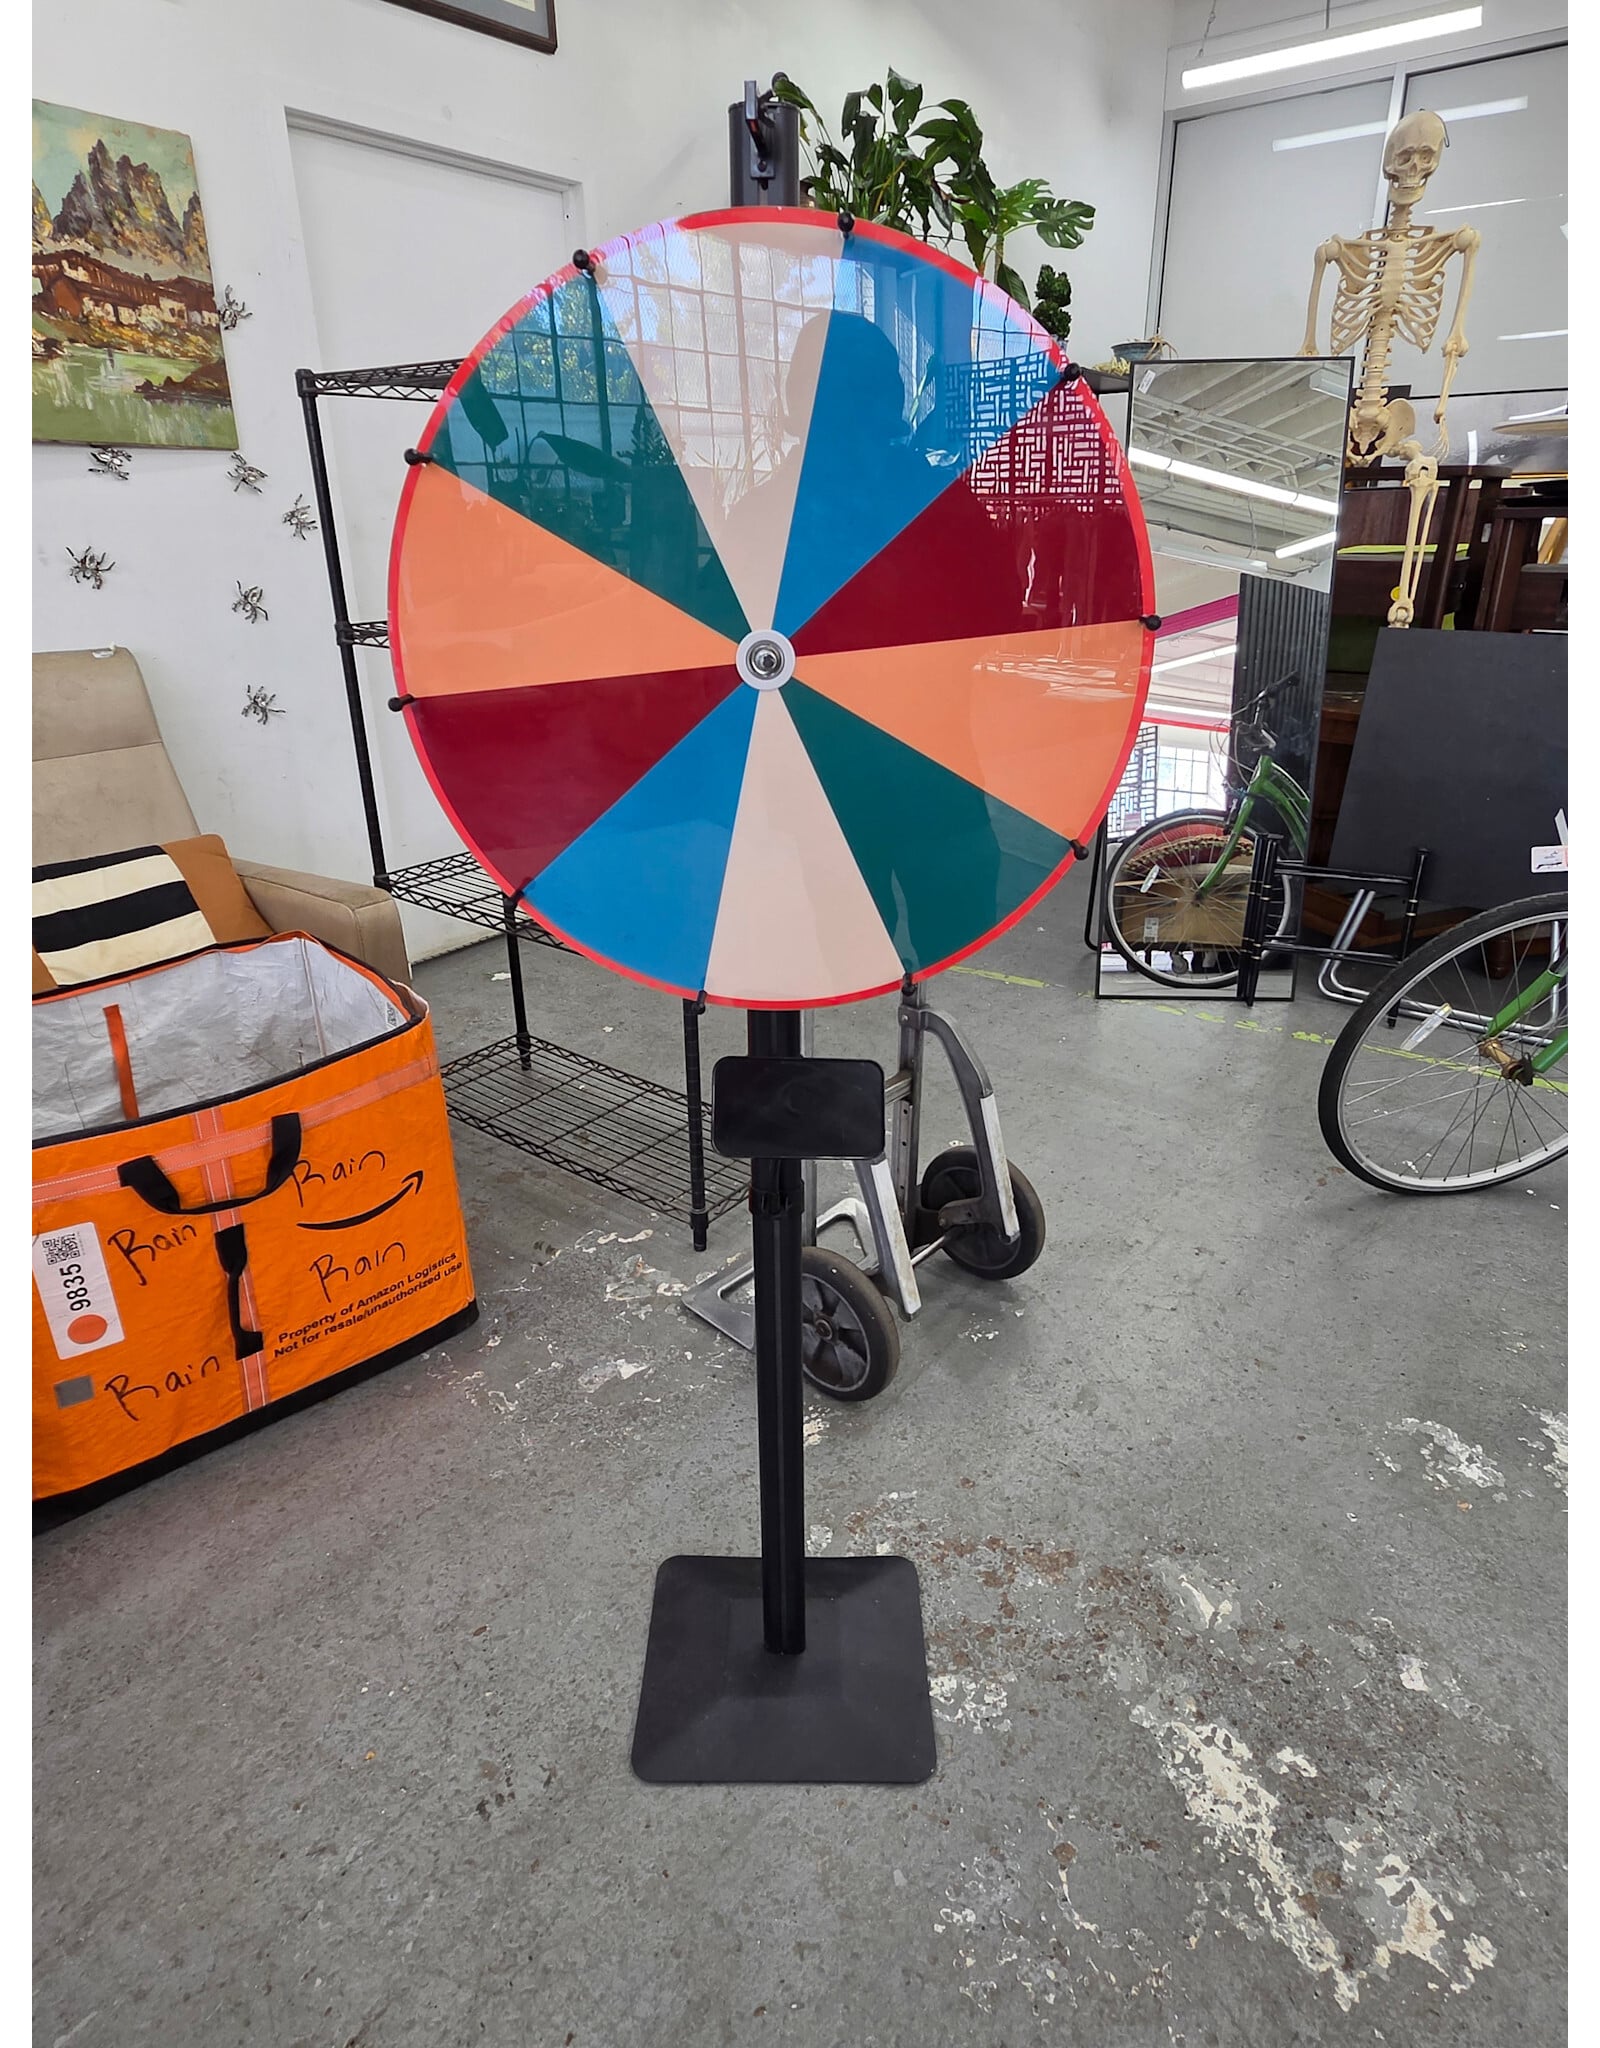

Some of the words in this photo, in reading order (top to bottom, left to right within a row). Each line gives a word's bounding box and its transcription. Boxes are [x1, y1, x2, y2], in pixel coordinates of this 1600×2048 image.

[291, 1150, 386, 1208] Rain
[59, 1263, 91, 1311] 9835
[107, 1224, 197, 1287] Rain
[309, 1241, 406, 1303] Rain
[274, 1341, 299, 1358] Not
[302, 1332, 321, 1346] for
[324, 1272, 441, 1336] resale/unauthorized
[444, 1261, 463, 1278] use
[279, 1312, 337, 1343] Property
[340, 1303, 354, 1317] of
[356, 1279, 405, 1310] Amazon
[407, 1252, 457, 1283] Logistics
[104, 1355, 220, 1422] Rain
